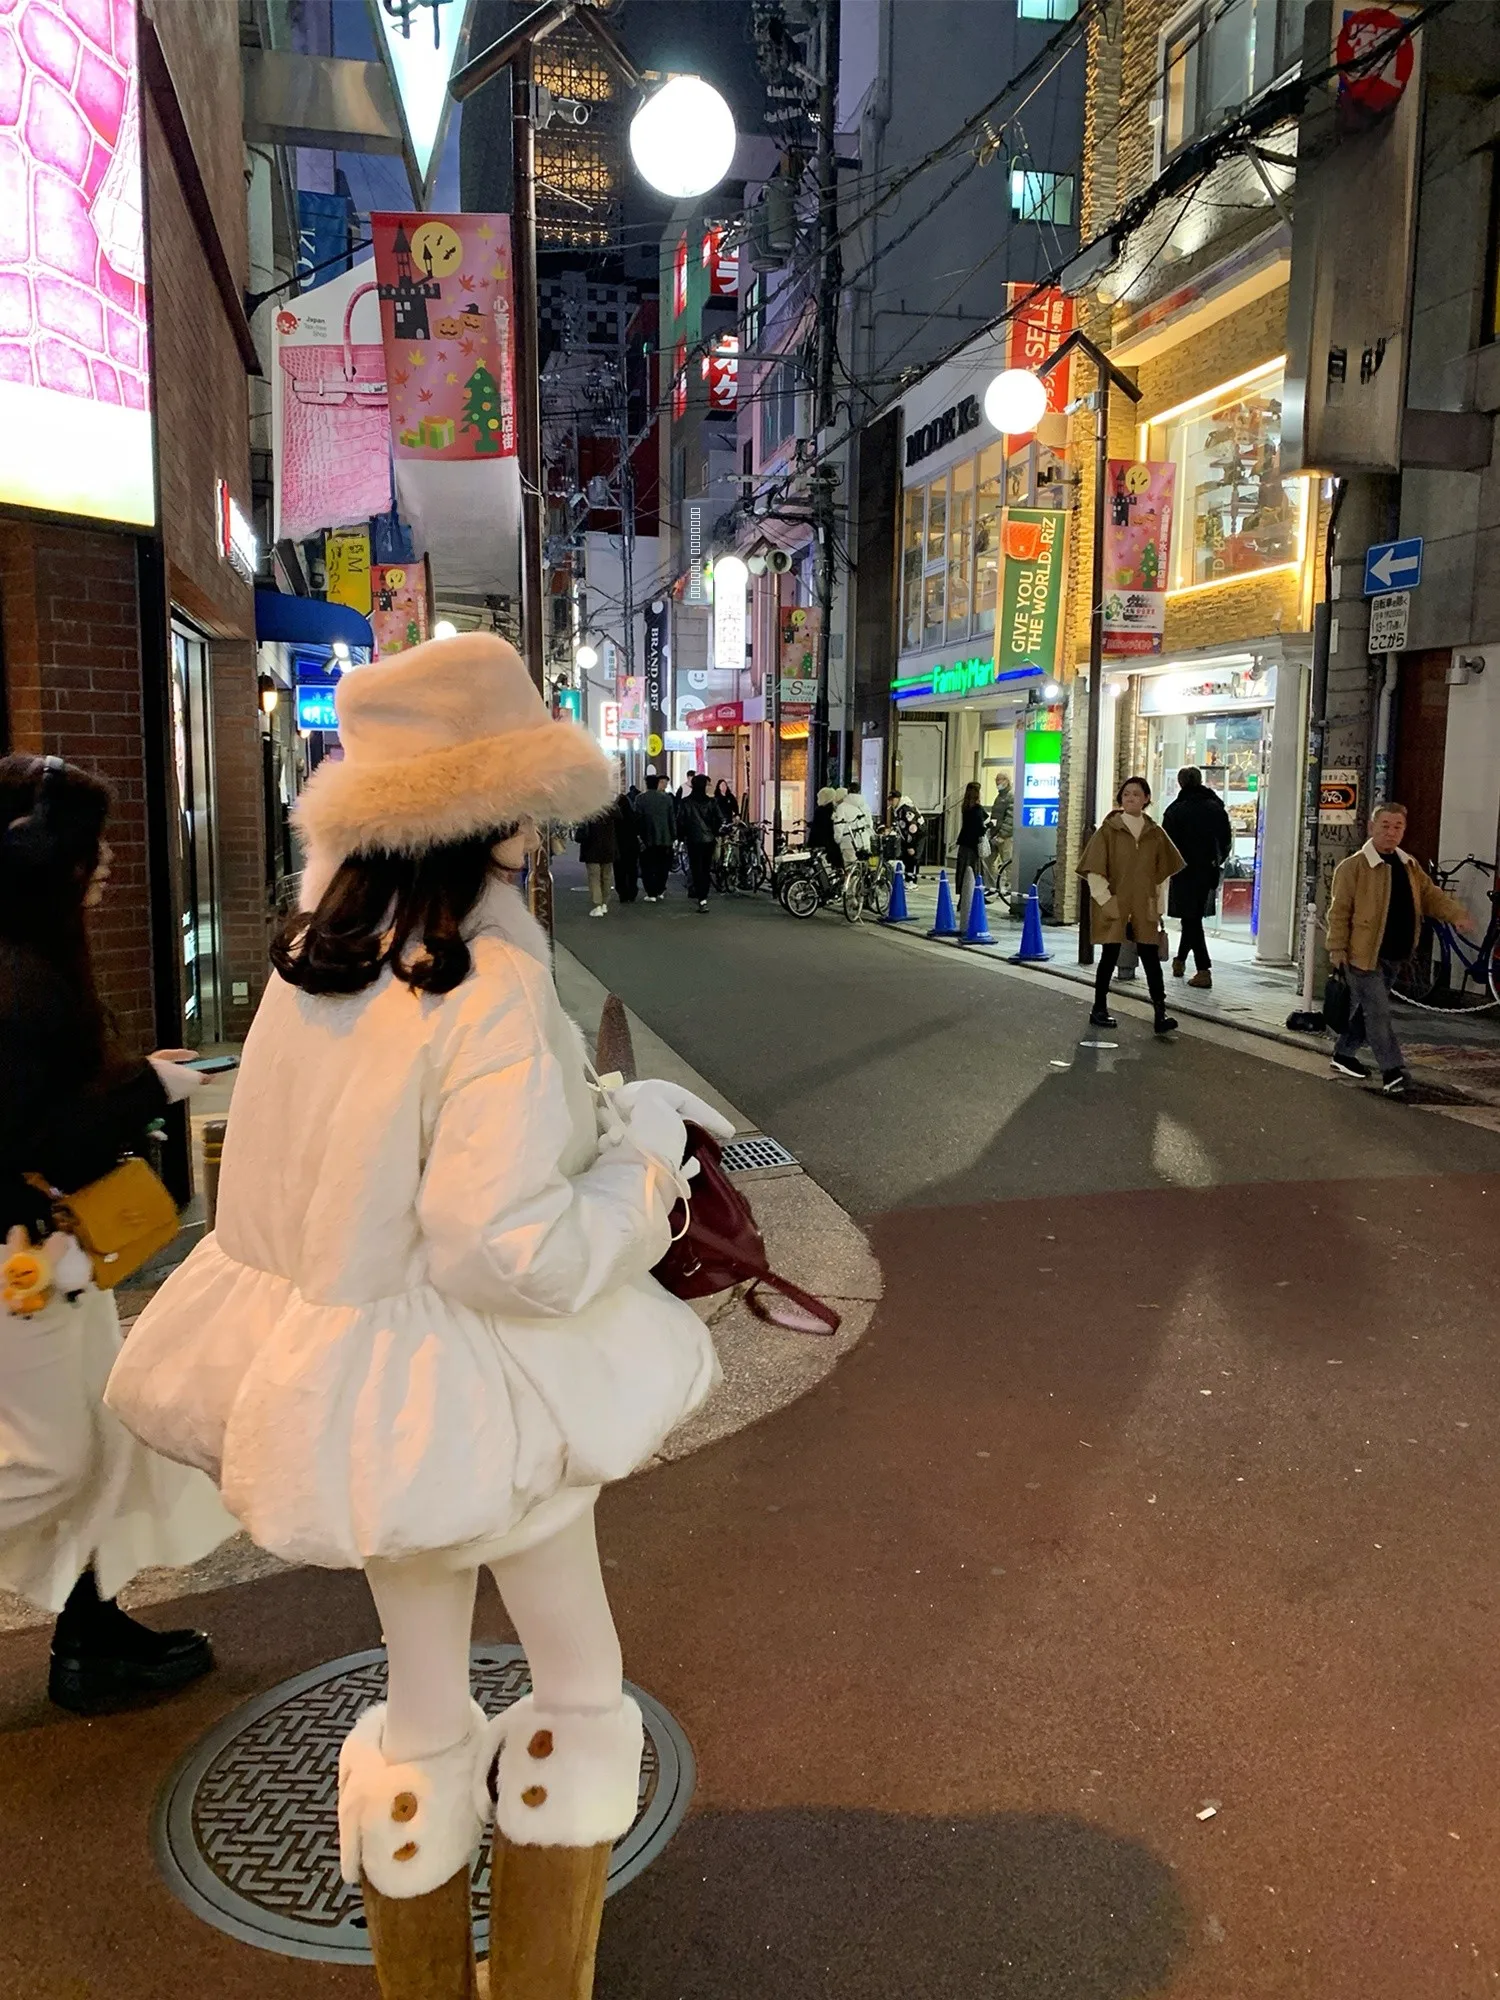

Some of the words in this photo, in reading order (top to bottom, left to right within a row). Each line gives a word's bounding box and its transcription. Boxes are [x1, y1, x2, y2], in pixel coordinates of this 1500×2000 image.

[305, 315, 326, 324] Japan
[1025, 297, 1049, 359] SELL
[906, 406, 957, 467] MODE
[1016, 571, 1034, 609] YOU
[1031, 548, 1053, 614] WORLD.
[1373, 595, 1408, 611] 自転車を除く
[1011, 612, 1029, 653] GIVE
[1027, 620, 1044, 653] THE
[1370, 632, 1405, 651] ここから
[650, 627, 659, 678] BRAND
[933, 657, 996, 696] FamilyMart
[650, 682, 659, 711] OFF
[1029, 808, 1046, 826] 酒
